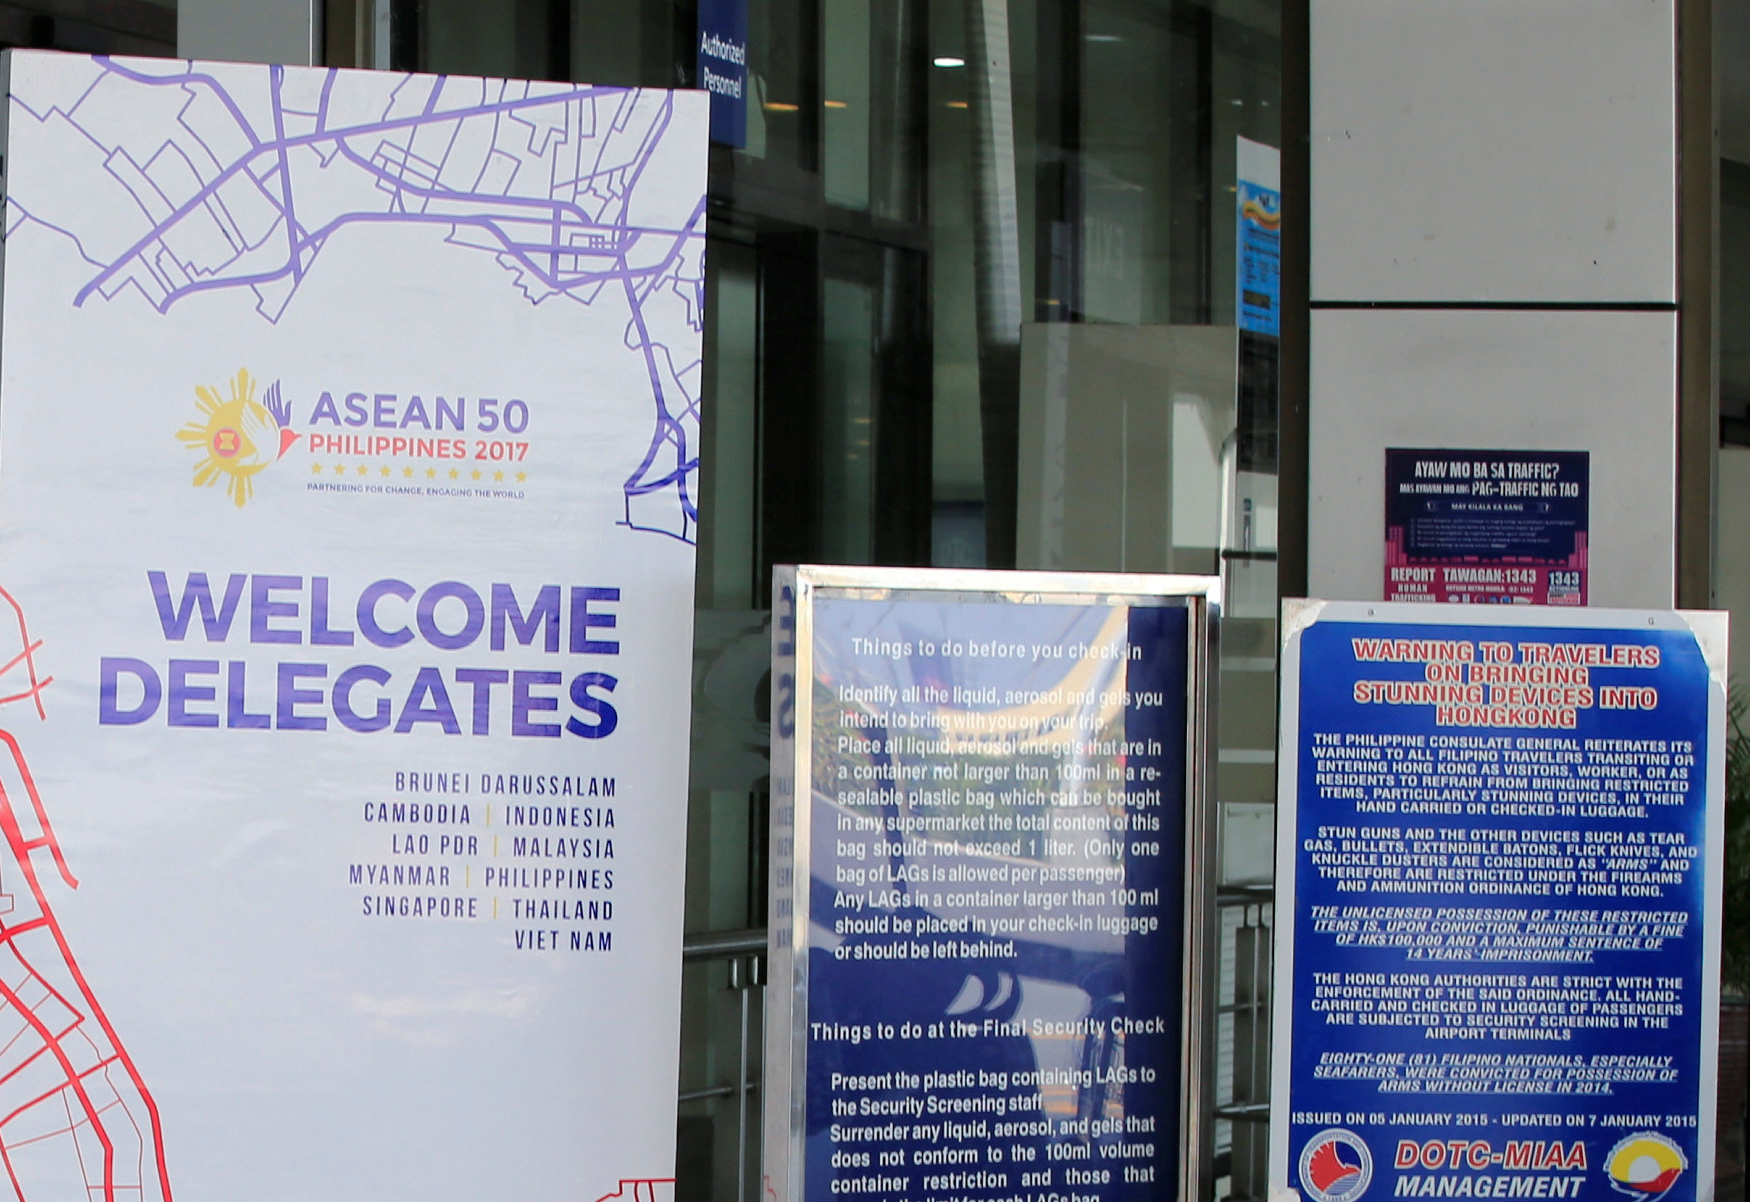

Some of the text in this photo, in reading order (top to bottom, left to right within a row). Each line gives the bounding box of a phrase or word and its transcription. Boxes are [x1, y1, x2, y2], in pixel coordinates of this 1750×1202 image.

[701, 31, 745, 65] Authorized
[704, 66, 742, 99] Personnel
[309, 391, 529, 434] ASEAN 50
[309, 434, 529, 462] PHILIPPINES 2017
[1414, 461, 1559, 480] AYAW MO BA SA TRAFFIC?
[307, 483, 363, 493] PARTNERING
[365, 485, 383, 494] FOR
[426, 487, 472, 497] ENGAGING
[474, 489, 490, 497] THE
[492, 490, 524, 499] WORLD
[1400, 481, 1578, 497] MAS AYAWAN MO ANG PAG-TRAFFIC NG TAO
[1391, 568, 1435, 582] REPORT
[1549, 572, 1579, 585] 1343
[1398, 583, 1427, 592] HUMAN
[147, 570, 621, 654] WELCOME
[852, 638, 911, 659] Things
[918, 640, 934, 656] to
[941, 640, 962, 656] do
[969, 640, 1025, 656] before
[1032, 645, 1062, 661] you
[1352, 639, 1660, 667] WARNING TO TRAVELERS
[1425, 663, 1589, 685] ON BRINGING
[100, 657, 618, 739] DELEGATES
[1354, 681, 1657, 709] STUNNING DEVICES INTO
[1436, 706, 1576, 729] HONGKONG
[1314, 733, 1691, 752] THE PHILIPPINE CONSULATE GENERAL REITERATES ITS
[1312, 747, 1693, 765] WARNING TO ALL FILIPINO TRAVELERS TRANSITING OR
[1317, 760, 1387, 773] ENTERING
[1393, 761, 1432, 773] HONG
[1437, 762, 1476, 774] KONG
[1481, 763, 1499, 774] AS
[1646, 767, 1665, 778] OR
[1670, 767, 1687, 778] AS
[395, 772, 616, 797] BRUNEI DARUSSALAM
[1316, 773, 1688, 791] RESIDENTS TO REFRAIN FROM BRINGING RESTRICTED
[364, 802, 614, 828] CAMBODIA INDONESIA
[1356, 801, 1395, 812] HAND
[1400, 801, 1461, 813] CARRIED
[1466, 803, 1485, 813] OR
[1490, 803, 1575, 815] CHECKED-IN
[392, 834, 614, 859] LAO PDR MALAYSIA
[349, 864, 613, 890] MYANMAR PHILIPPINES
[363, 896, 612, 920] SINGAPORE THAILAND
[515, 930, 611, 951] VIET NAM
[811, 1017, 1165, 1044] Things to do at the Final Security Check
[832, 1067, 1155, 1091] Present the plastic bag containing LAGs to
[832, 1093, 1041, 1117] the Security Screening staff
[831, 1115, 1154, 1142] Surrender any liquid, aerosol, and gels that
[1292, 1111, 1696, 1127] ISSUED ON 05 JANUARY 2015 UPDATED ON 7 JANUARY 2015
[831, 1142, 1154, 1167] does not conform to the 100ml volume
[1394, 1140, 1587, 1169] DOTC-MIAA
[831, 1166, 1153, 1192] container restriction and those that
[1394, 1176, 1585, 1198] MANAGEMENT
